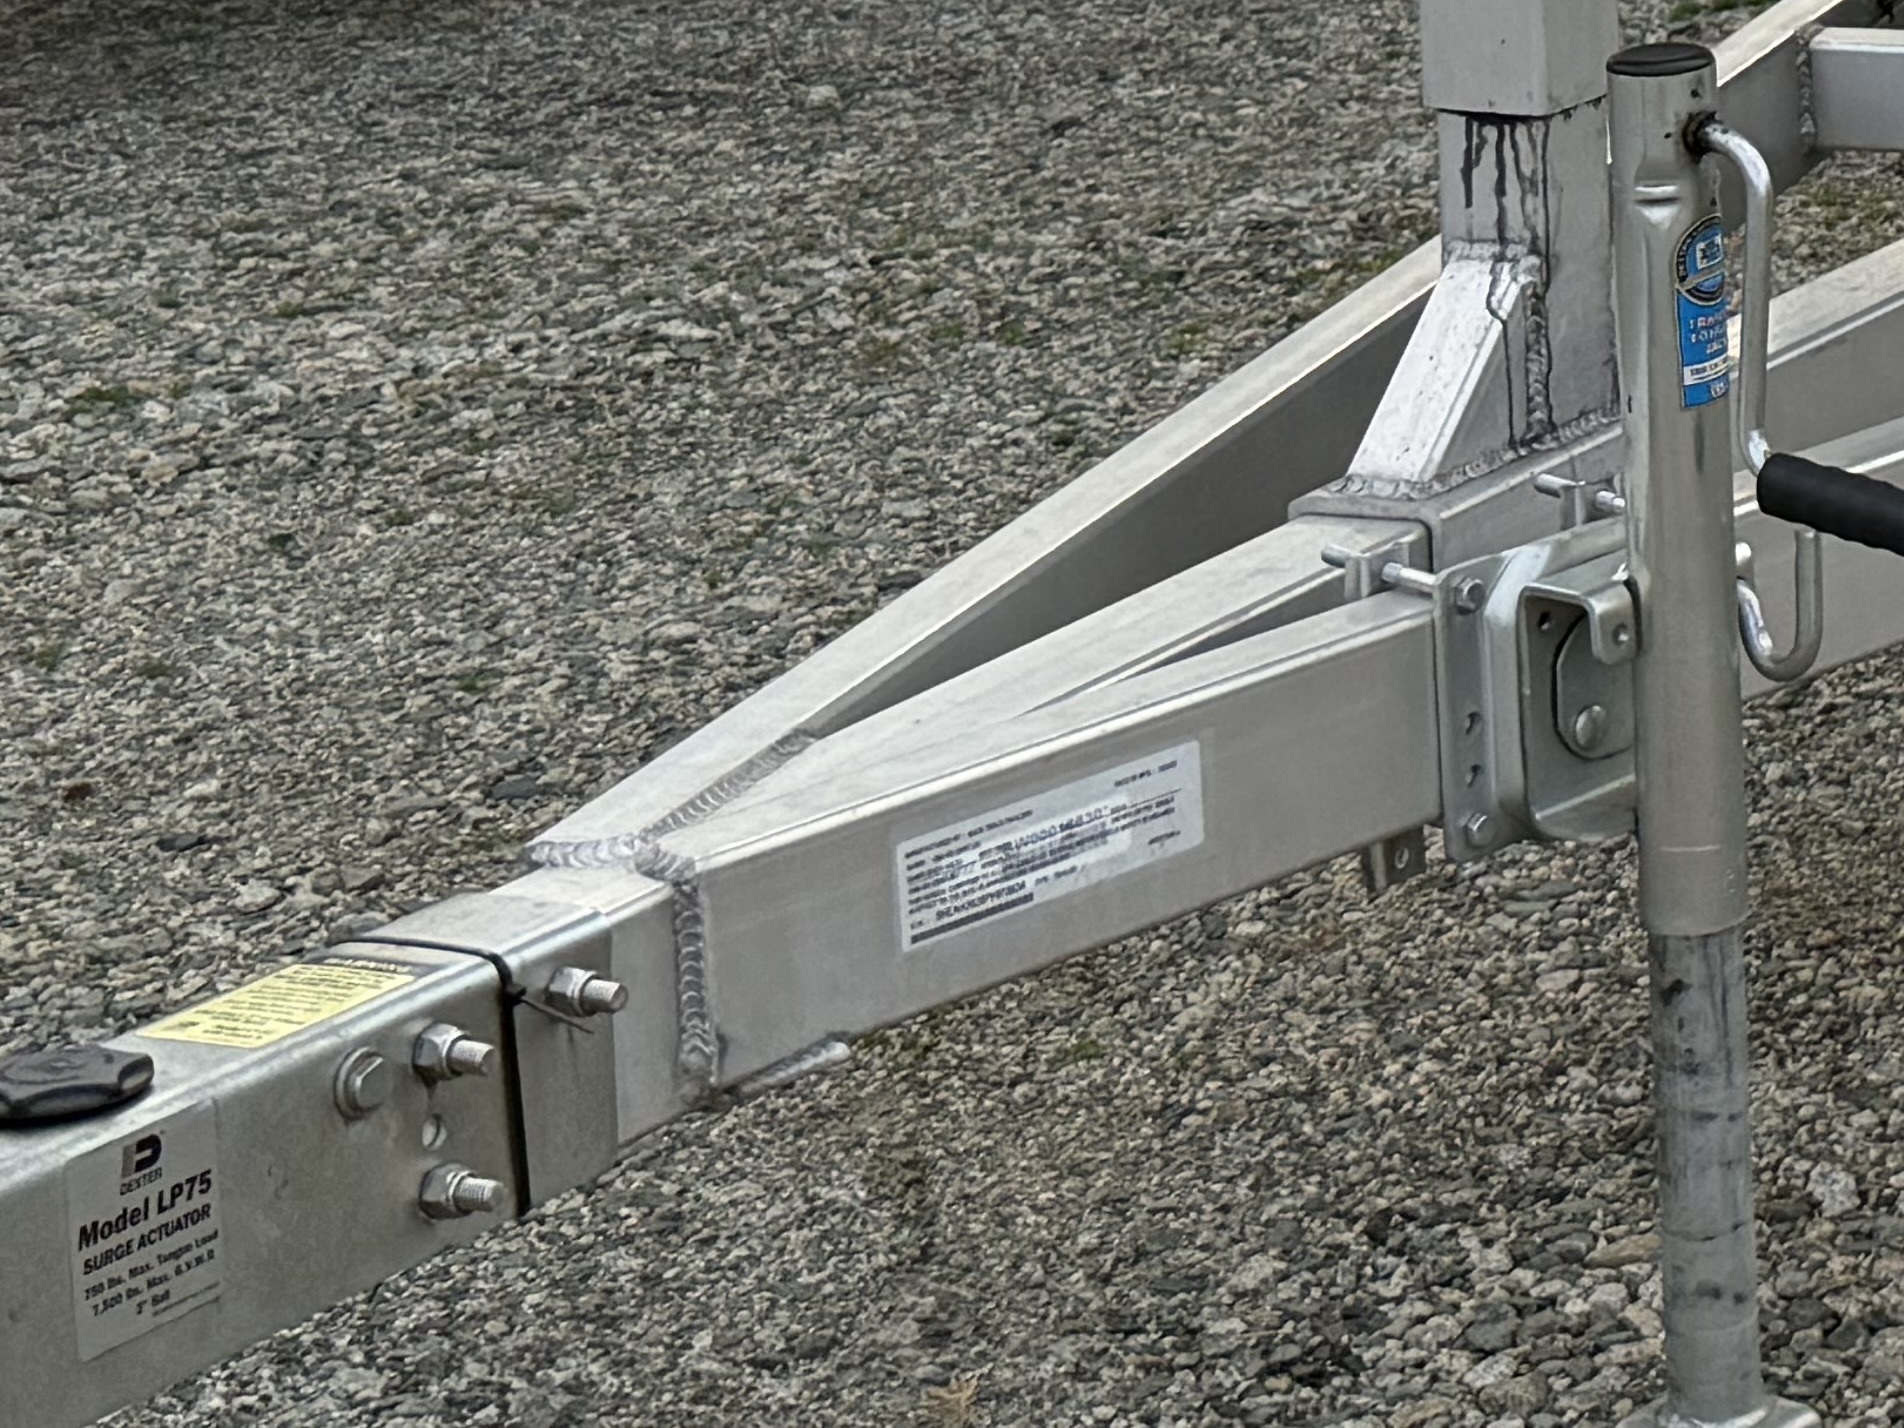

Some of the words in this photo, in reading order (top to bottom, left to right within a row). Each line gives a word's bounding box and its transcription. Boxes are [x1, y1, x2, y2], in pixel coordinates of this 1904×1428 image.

[78, 1196, 149, 1252] Model
[157, 1168, 212, 1214] LP75
[83, 1238, 134, 1275] SURGE
[137, 1203, 211, 1251] ACTUATOR
